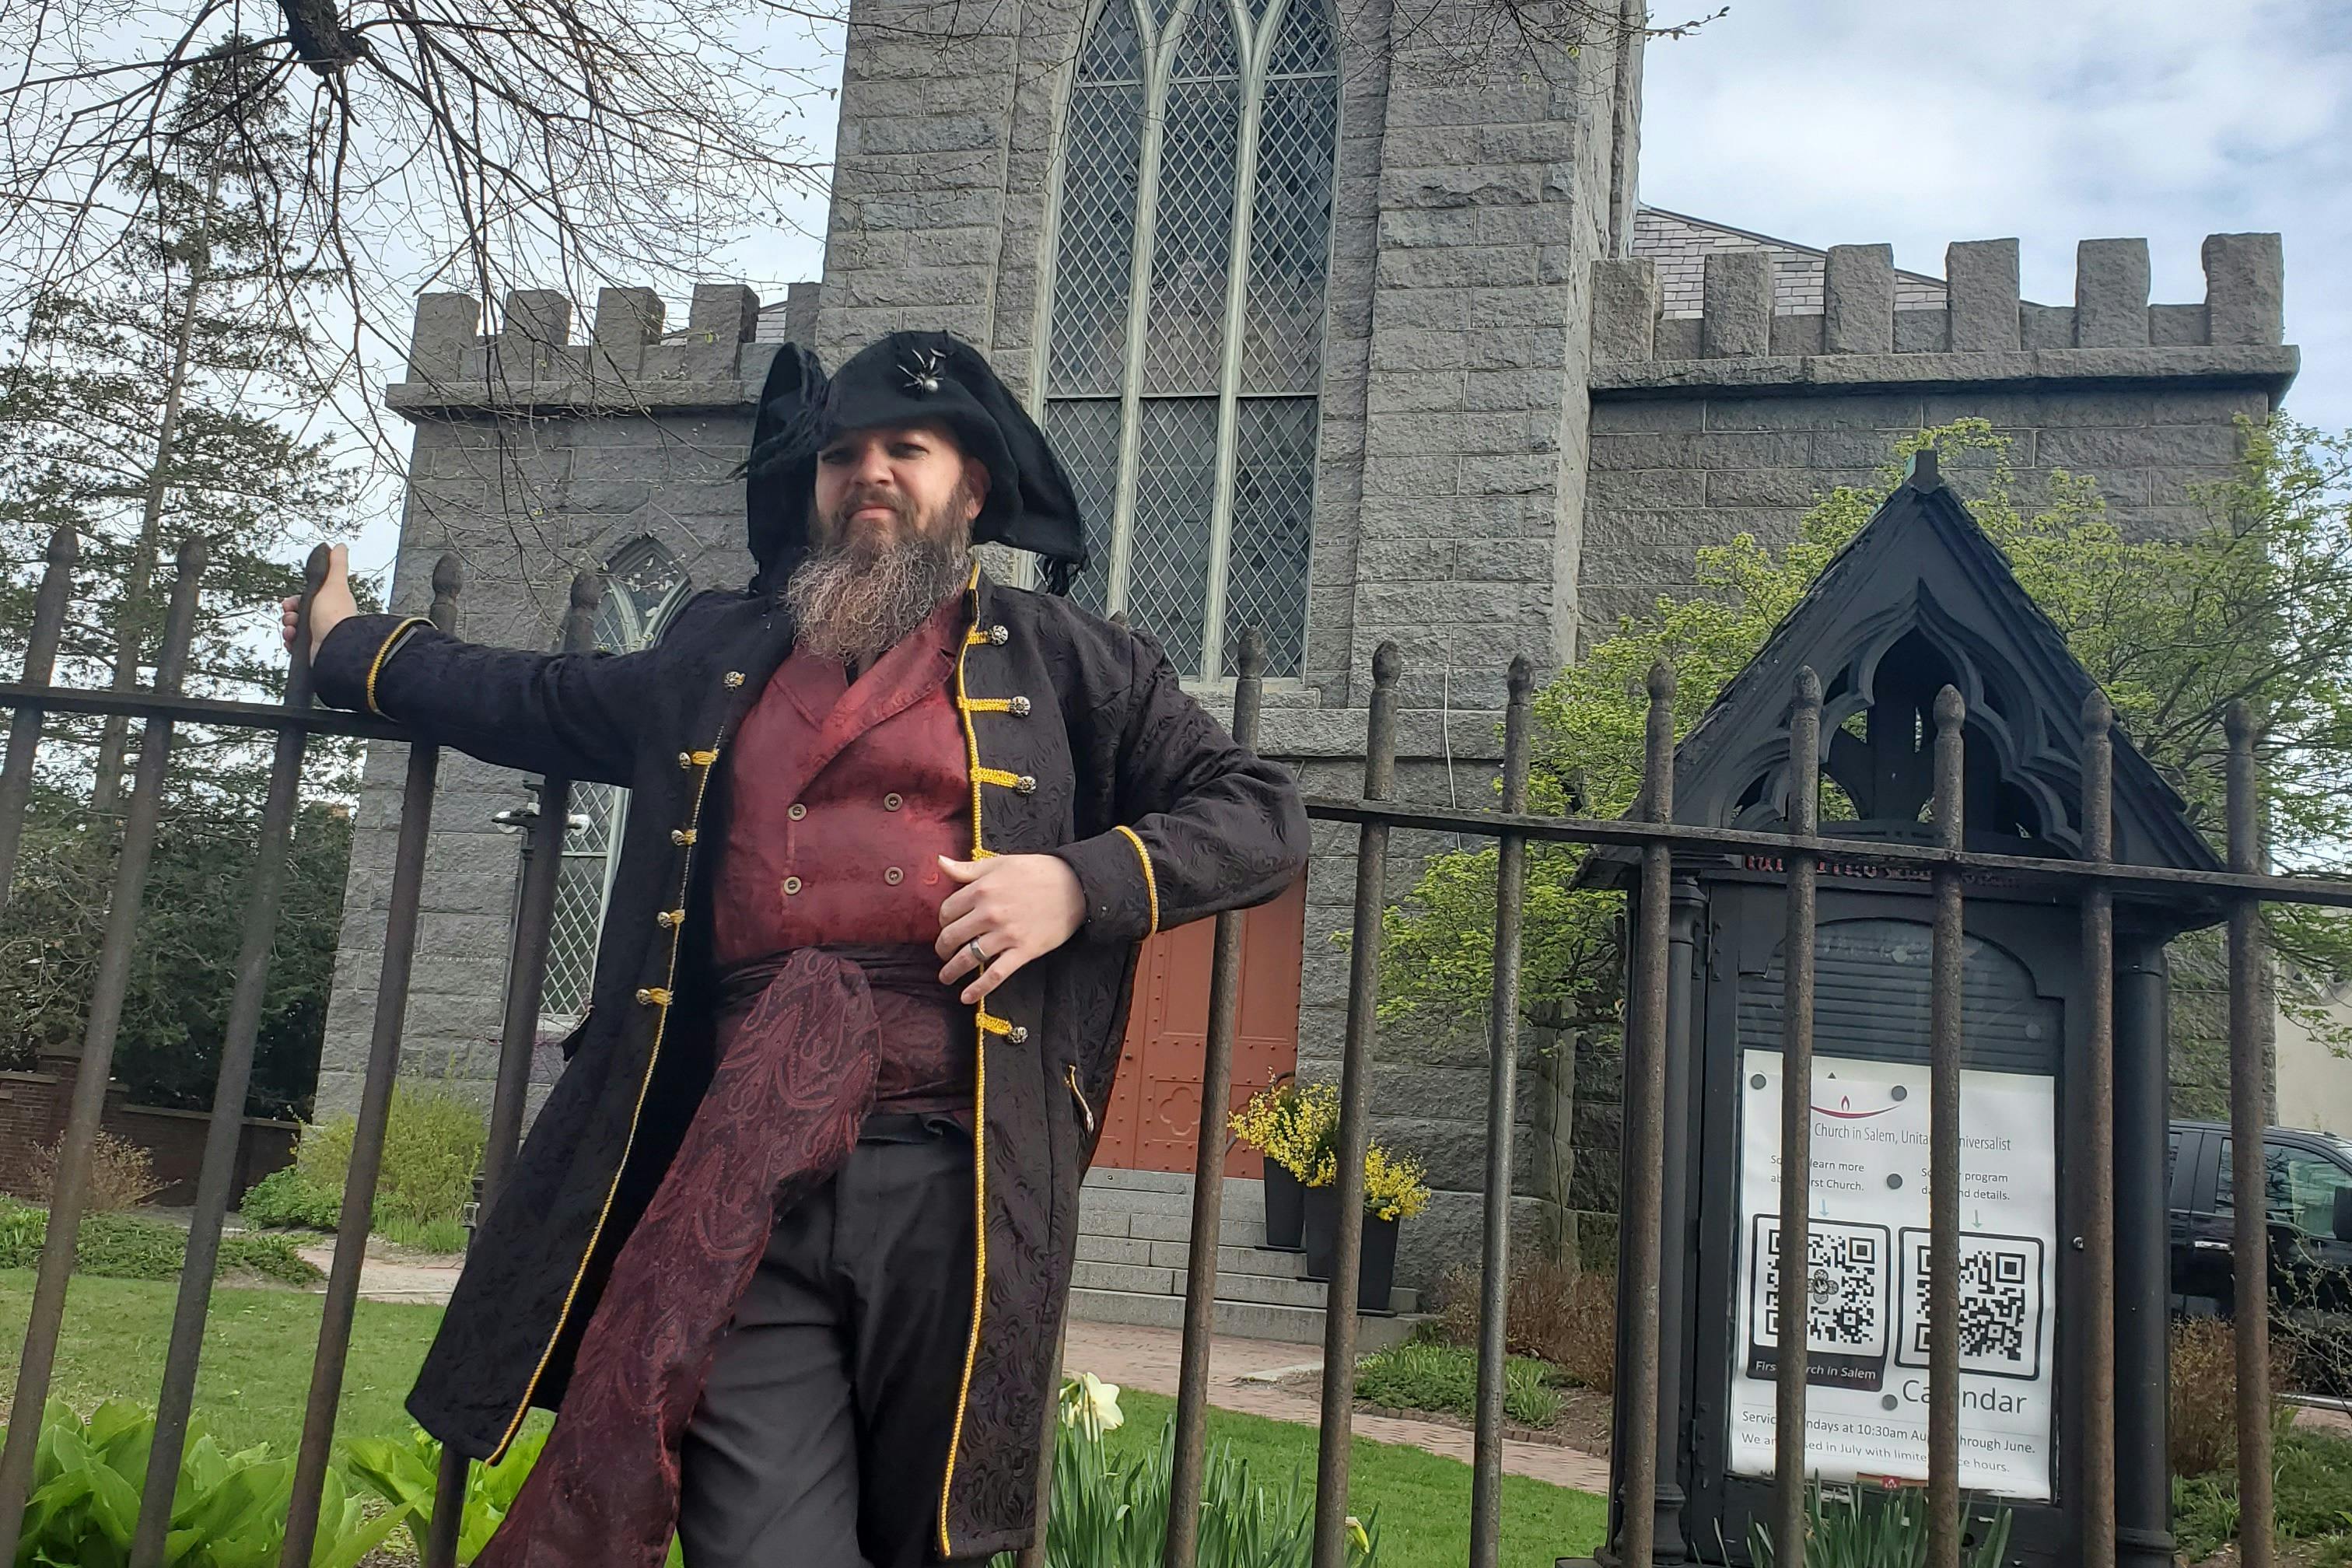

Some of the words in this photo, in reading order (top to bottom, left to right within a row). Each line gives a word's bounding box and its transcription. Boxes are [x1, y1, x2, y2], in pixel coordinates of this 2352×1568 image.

[1815, 1122, 1850, 1139] Church
[1853, 1125, 1861, 1139] in
[1864, 1128, 1898, 1145] Salem,
[1902, 1130, 1929, 1146] Unita
[1959, 1136, 2011, 1150] niversalist
[1810, 1158, 1836, 1170] learn
[1839, 1163, 1864, 1172] more
[1826, 1179, 1864, 1191] Church.
[1965, 1173, 2008, 1184] program
[1973, 1189, 2010, 1200] details.
[1755, 1361, 1777, 1372] Firs
[1828, 1366, 1838, 1376] in
[1840, 1367, 1876, 1380] Salem
[1902, 1380, 2028, 1414] Candar
[1742, 1411, 1777, 1425] Servic
[1806, 1419, 1839, 1433] ndays
[1843, 1423, 1853, 1433] at
[1857, 1424, 1907, 1440] 10:30am
[1960, 1435, 2000, 1451] hrough
[2004, 1440, 2035, 1453] June.
[1741, 1433, 1760, 1444] We
[1826, 1442, 1836, 1451] in
[1840, 1444, 1862, 1456] July
[1866, 1447, 1891, 1458] with
[1895, 1450, 1927, 1462] limite
[1974, 1458, 2010, 1472] hours.
